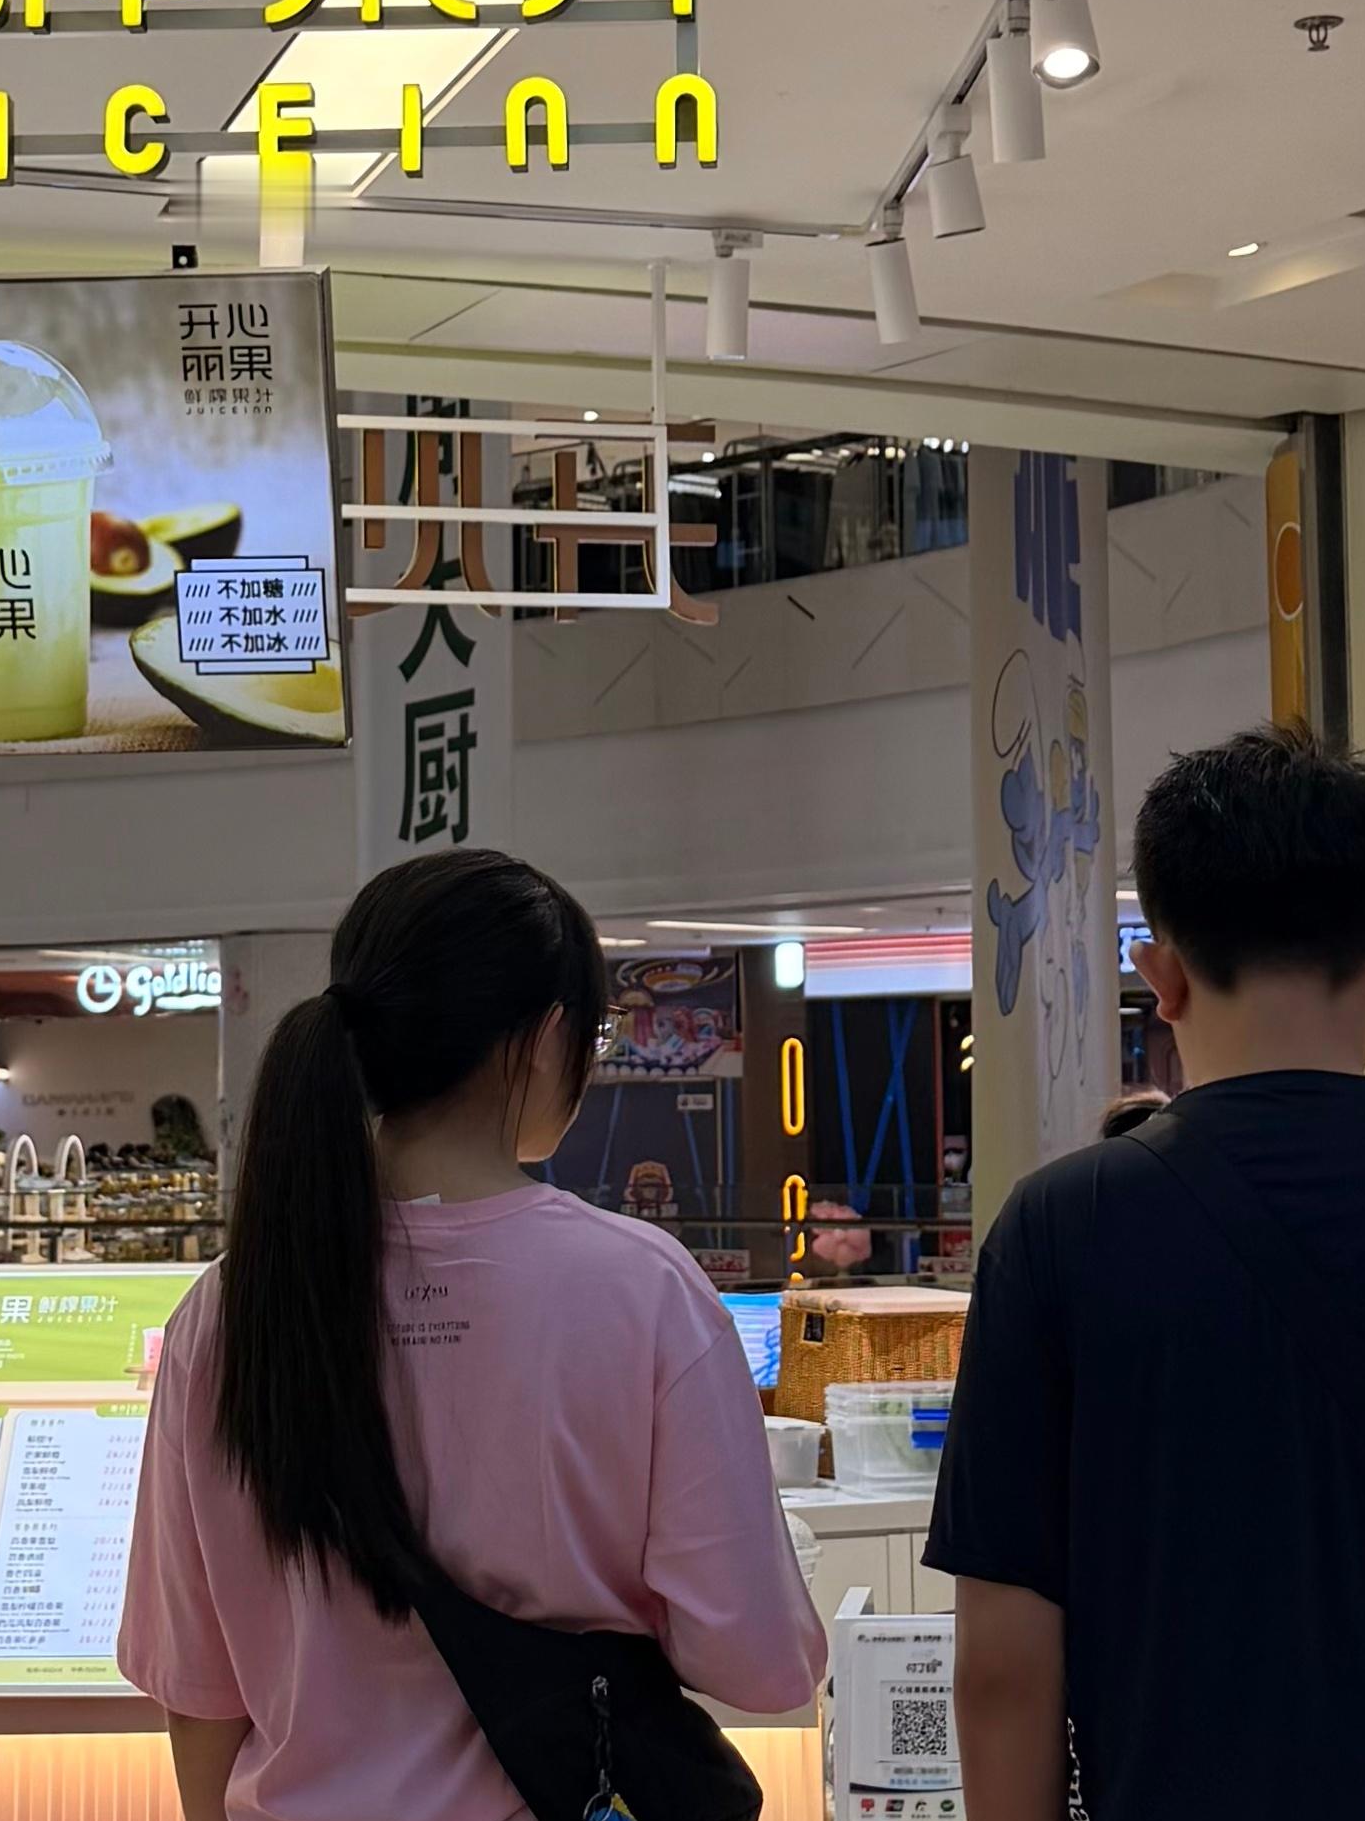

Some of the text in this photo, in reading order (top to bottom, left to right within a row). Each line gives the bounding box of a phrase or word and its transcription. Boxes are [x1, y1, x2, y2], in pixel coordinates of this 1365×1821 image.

[178, 304, 269, 339] 开心
[181, 346, 273, 381] 丽果
[217, 578, 284, 599] 不加糖
[219, 605, 286, 626] 不加水
[221, 632, 289, 653] 不加冰
[38, 1295, 119, 1314] 鲜榨果汁
